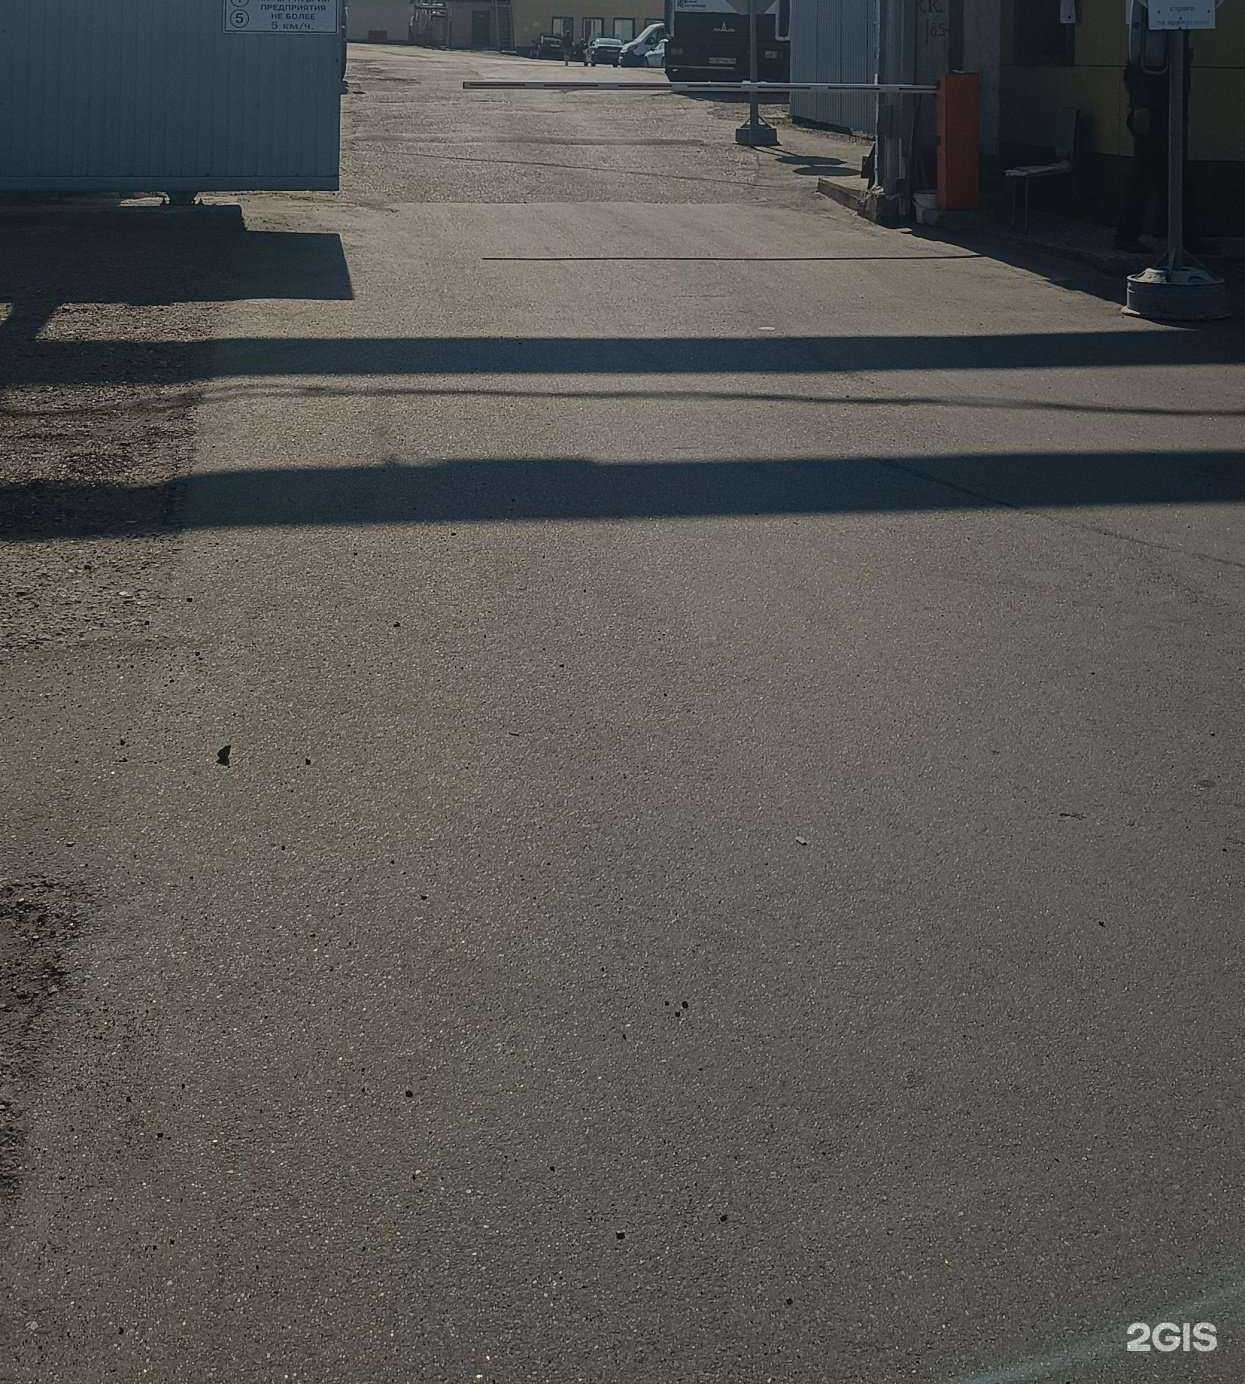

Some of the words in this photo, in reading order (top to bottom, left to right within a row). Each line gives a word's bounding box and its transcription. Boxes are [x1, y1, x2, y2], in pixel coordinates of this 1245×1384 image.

[235, 13, 244, 24] 5
[271, 12, 282, 20] НЕ
[271, 21, 278, 30] 5
